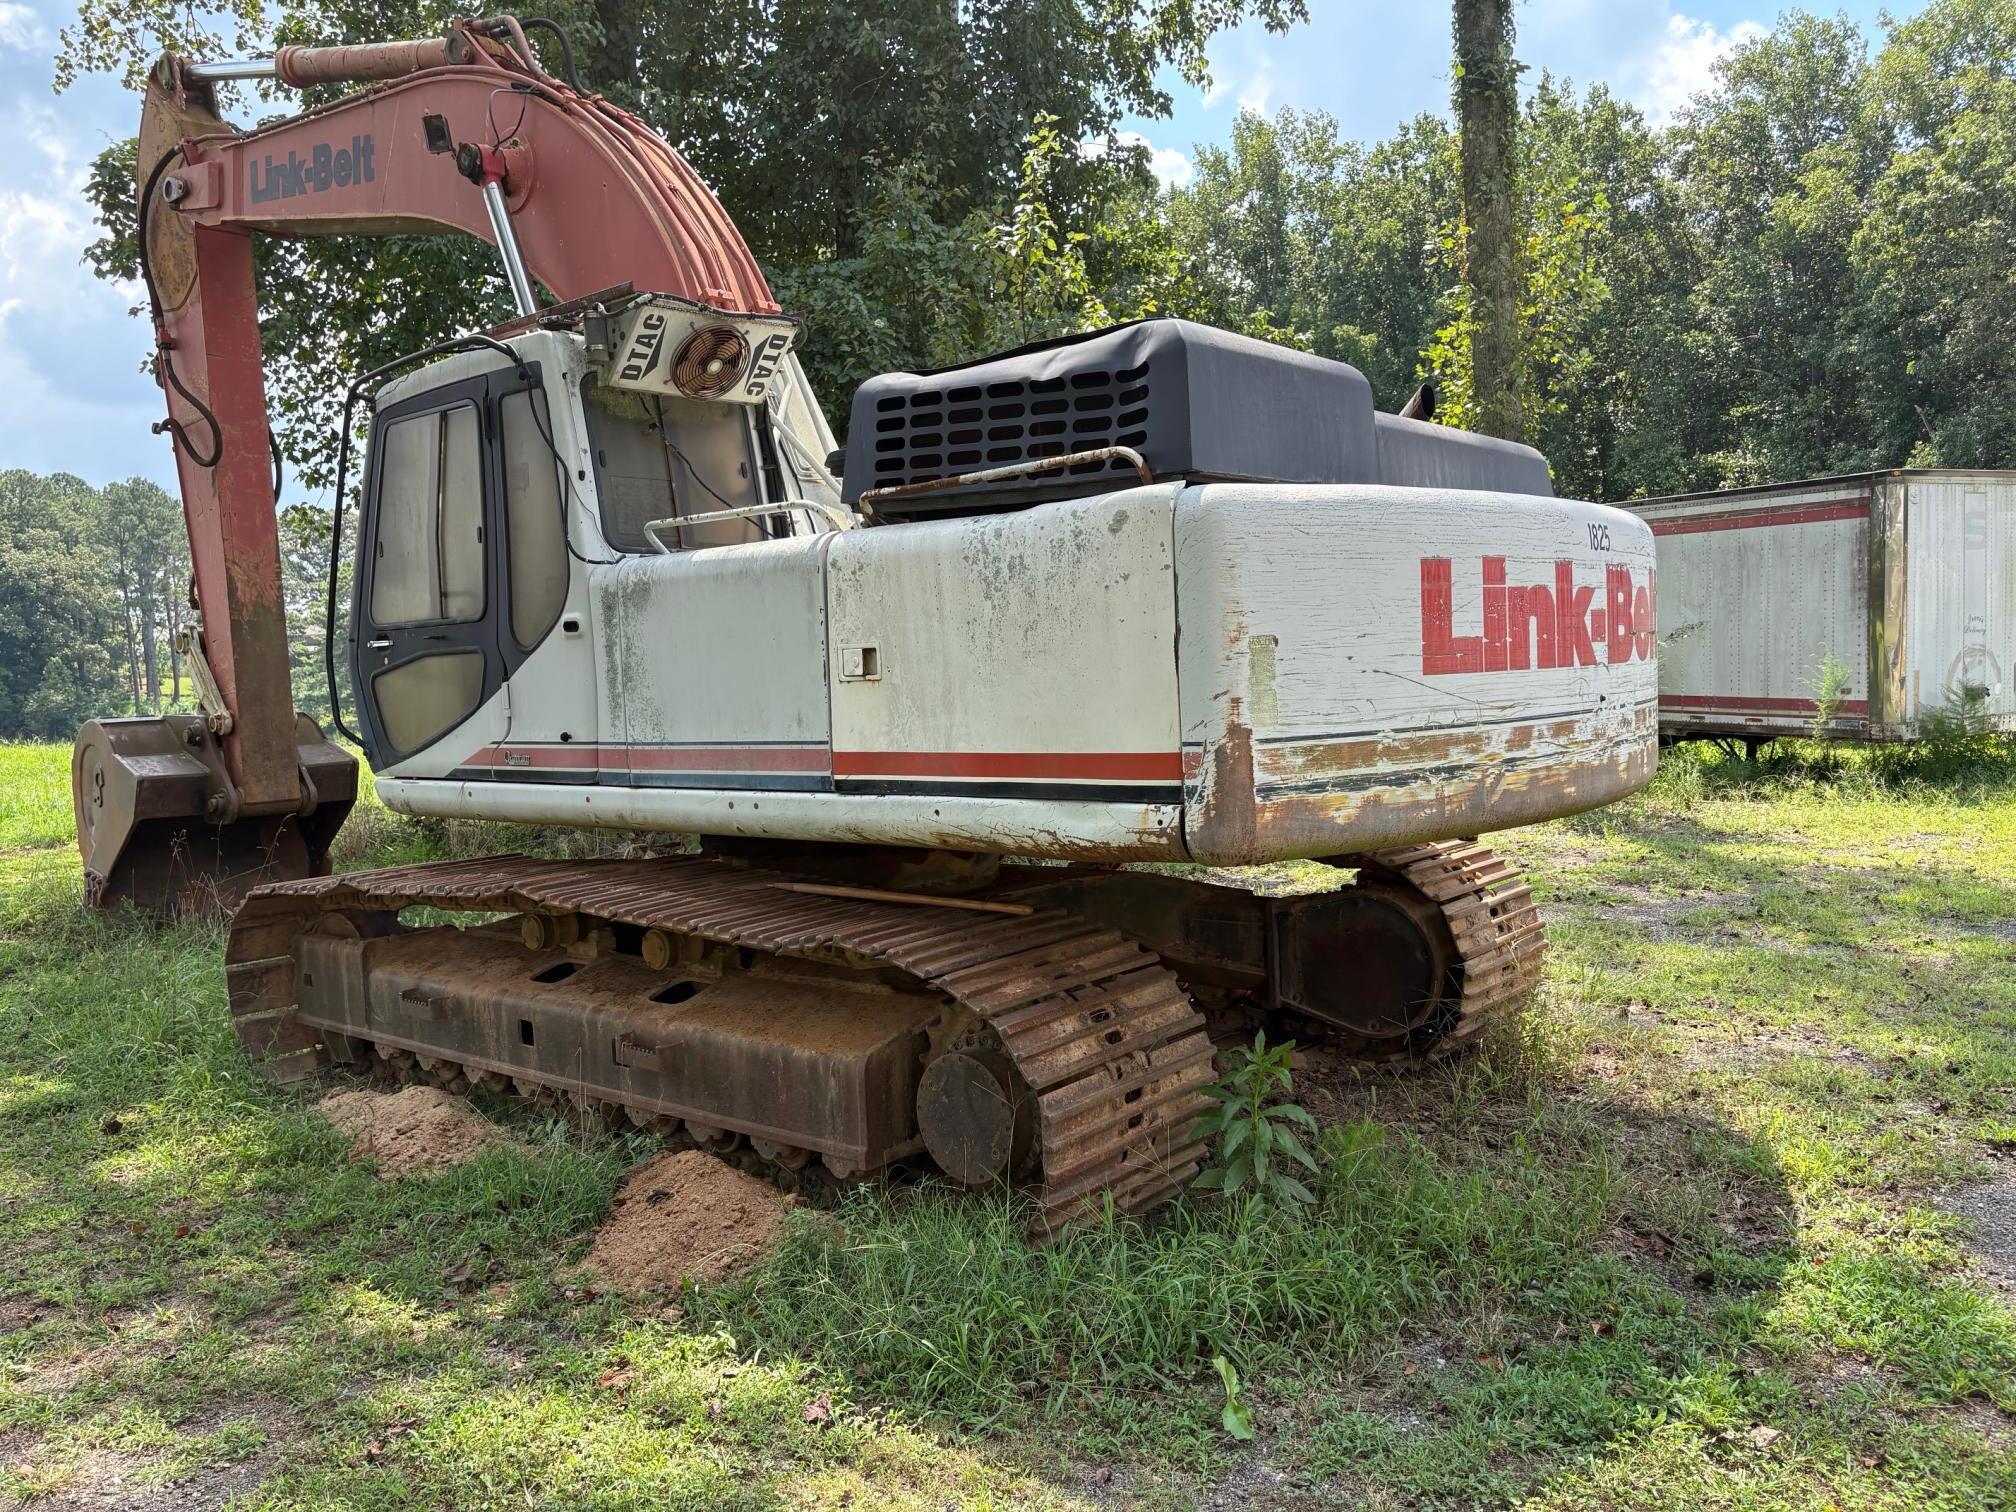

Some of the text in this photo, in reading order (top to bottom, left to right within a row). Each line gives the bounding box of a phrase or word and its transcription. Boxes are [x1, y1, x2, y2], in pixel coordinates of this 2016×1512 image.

[250, 134, 375, 204] Link-Belt
[619, 313, 665, 381] DTAC
[746, 334, 790, 397] DTAC
[1587, 523, 1611, 552] 1825
[1420, 554, 1657, 675] Link-Bel
